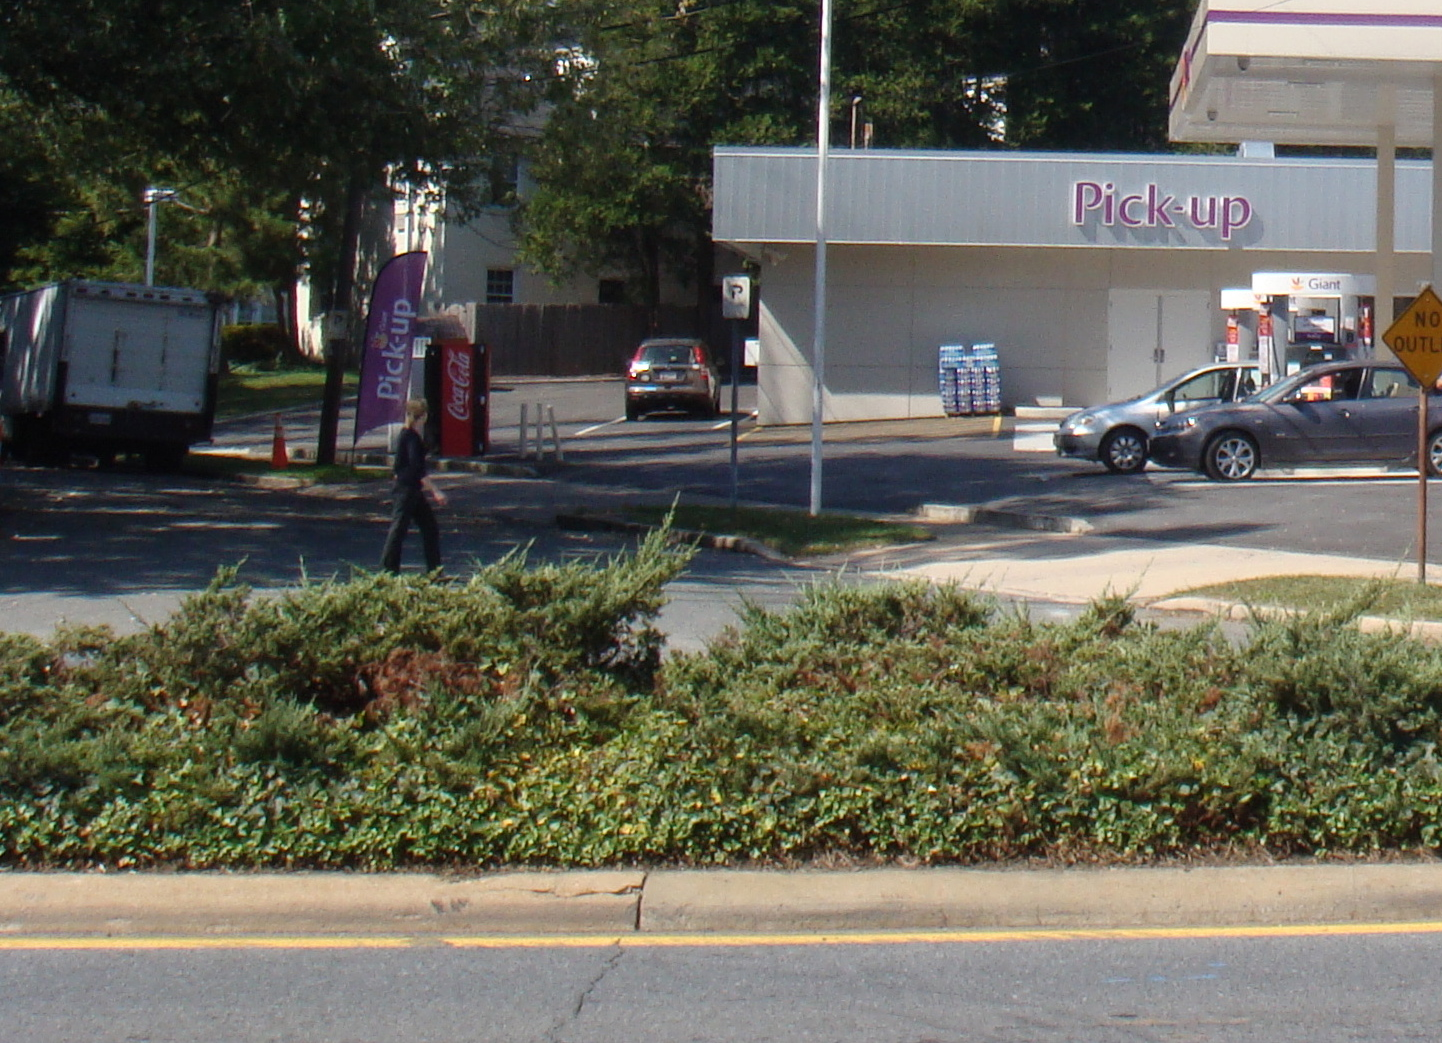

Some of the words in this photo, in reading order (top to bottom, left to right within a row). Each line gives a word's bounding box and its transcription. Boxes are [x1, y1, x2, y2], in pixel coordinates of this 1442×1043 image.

[1073, 180, 1252, 240] Pick-up
[1308, 277, 1341, 290] Giant
[1415, 311, 1440, 328] NO
[377, 298, 416, 400] Pick-up
